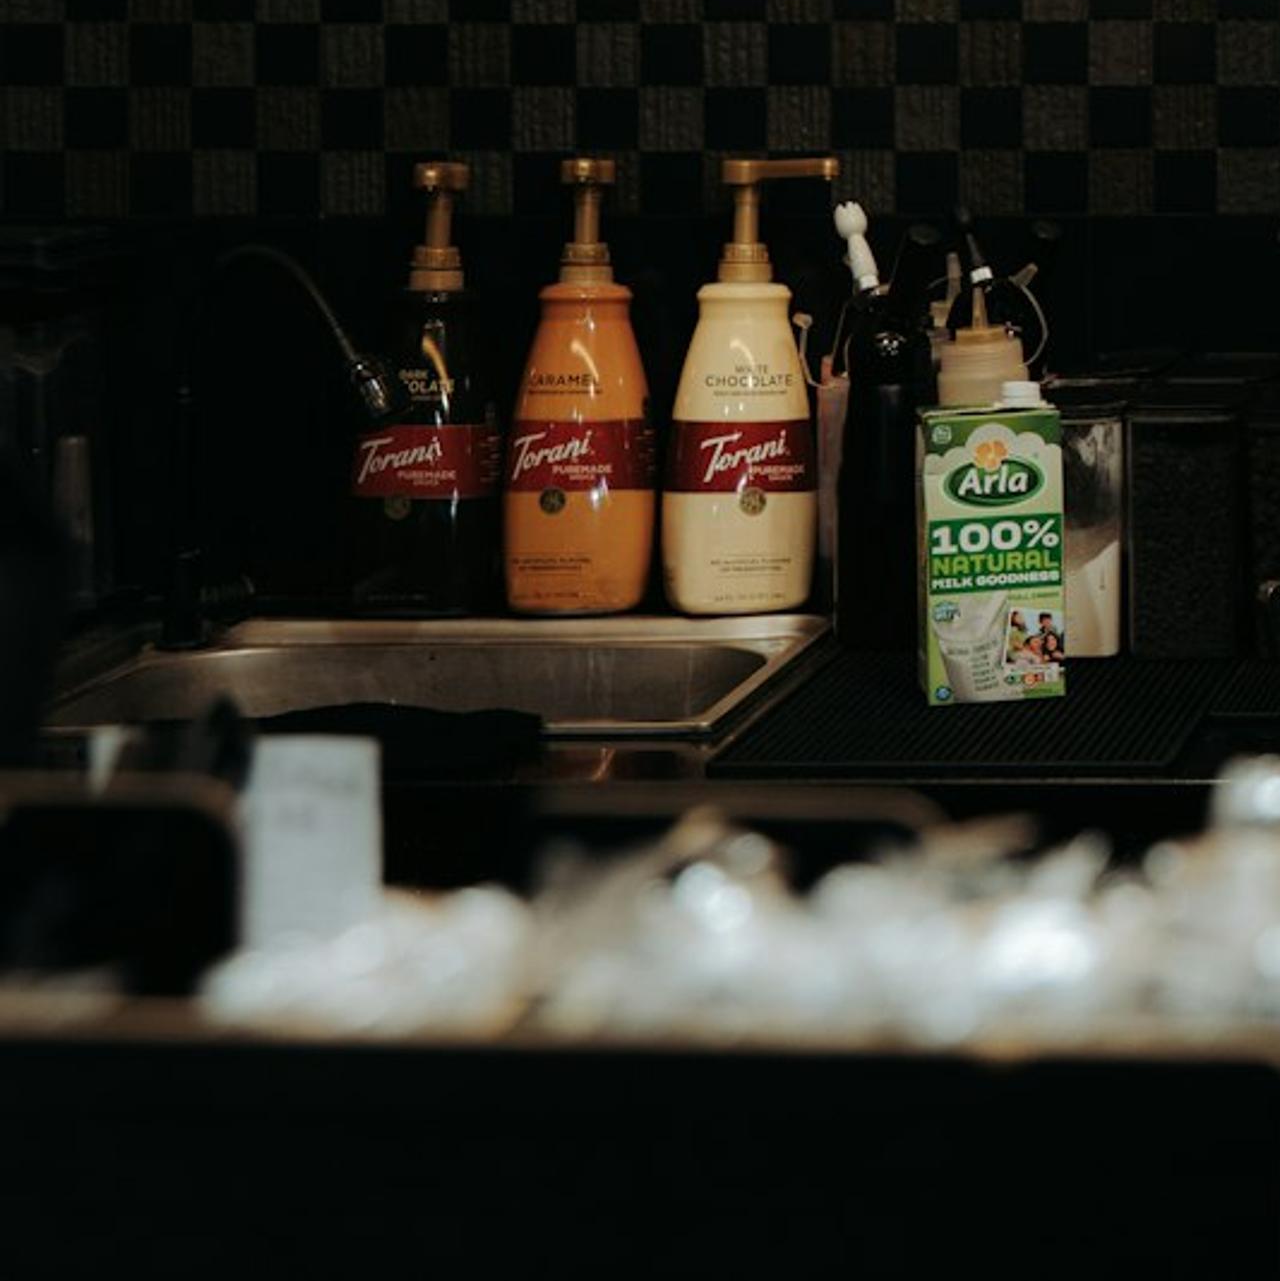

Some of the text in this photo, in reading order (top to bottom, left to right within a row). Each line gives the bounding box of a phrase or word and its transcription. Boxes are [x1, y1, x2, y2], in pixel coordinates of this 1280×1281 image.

[512, 429, 593, 481] Torani
[700, 429, 786, 483] Torani
[958, 463, 1029, 496] Arla
[931, 519, 1060, 556] 100%
[933, 549, 1060, 576] NATURAL
[931, 576, 974, 590] MILK
